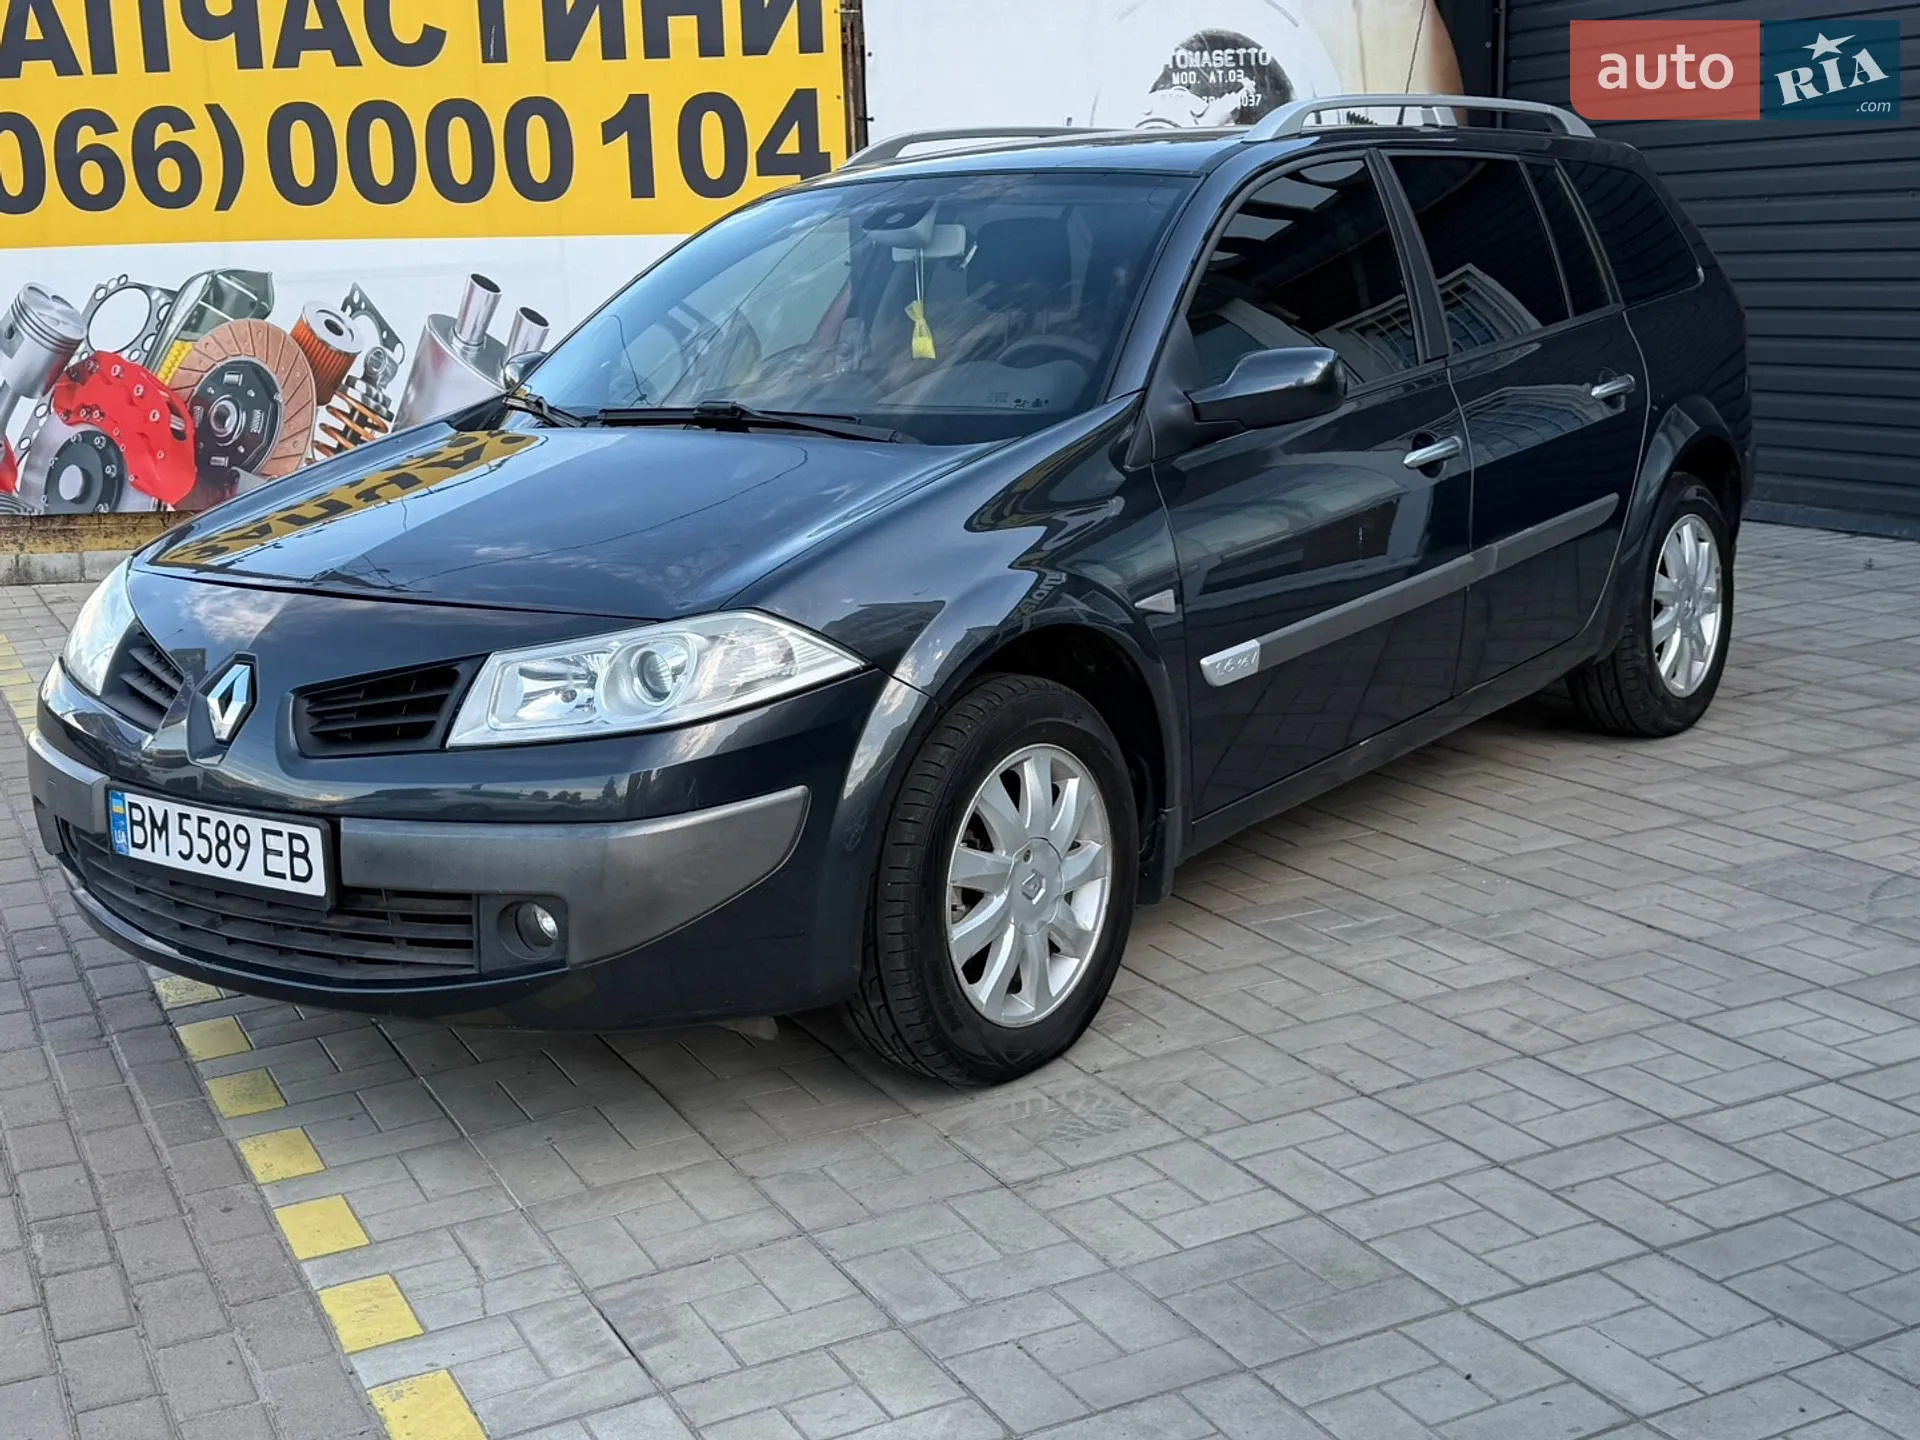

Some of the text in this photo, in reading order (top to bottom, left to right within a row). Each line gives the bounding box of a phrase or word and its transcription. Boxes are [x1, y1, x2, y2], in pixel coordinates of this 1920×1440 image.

[1167, 48, 1271, 69] TOMASETTO
[267, 96, 574, 206] 0000
[601, 88, 831, 199] 104
[127, 801, 313, 883] BM 5589 EB
